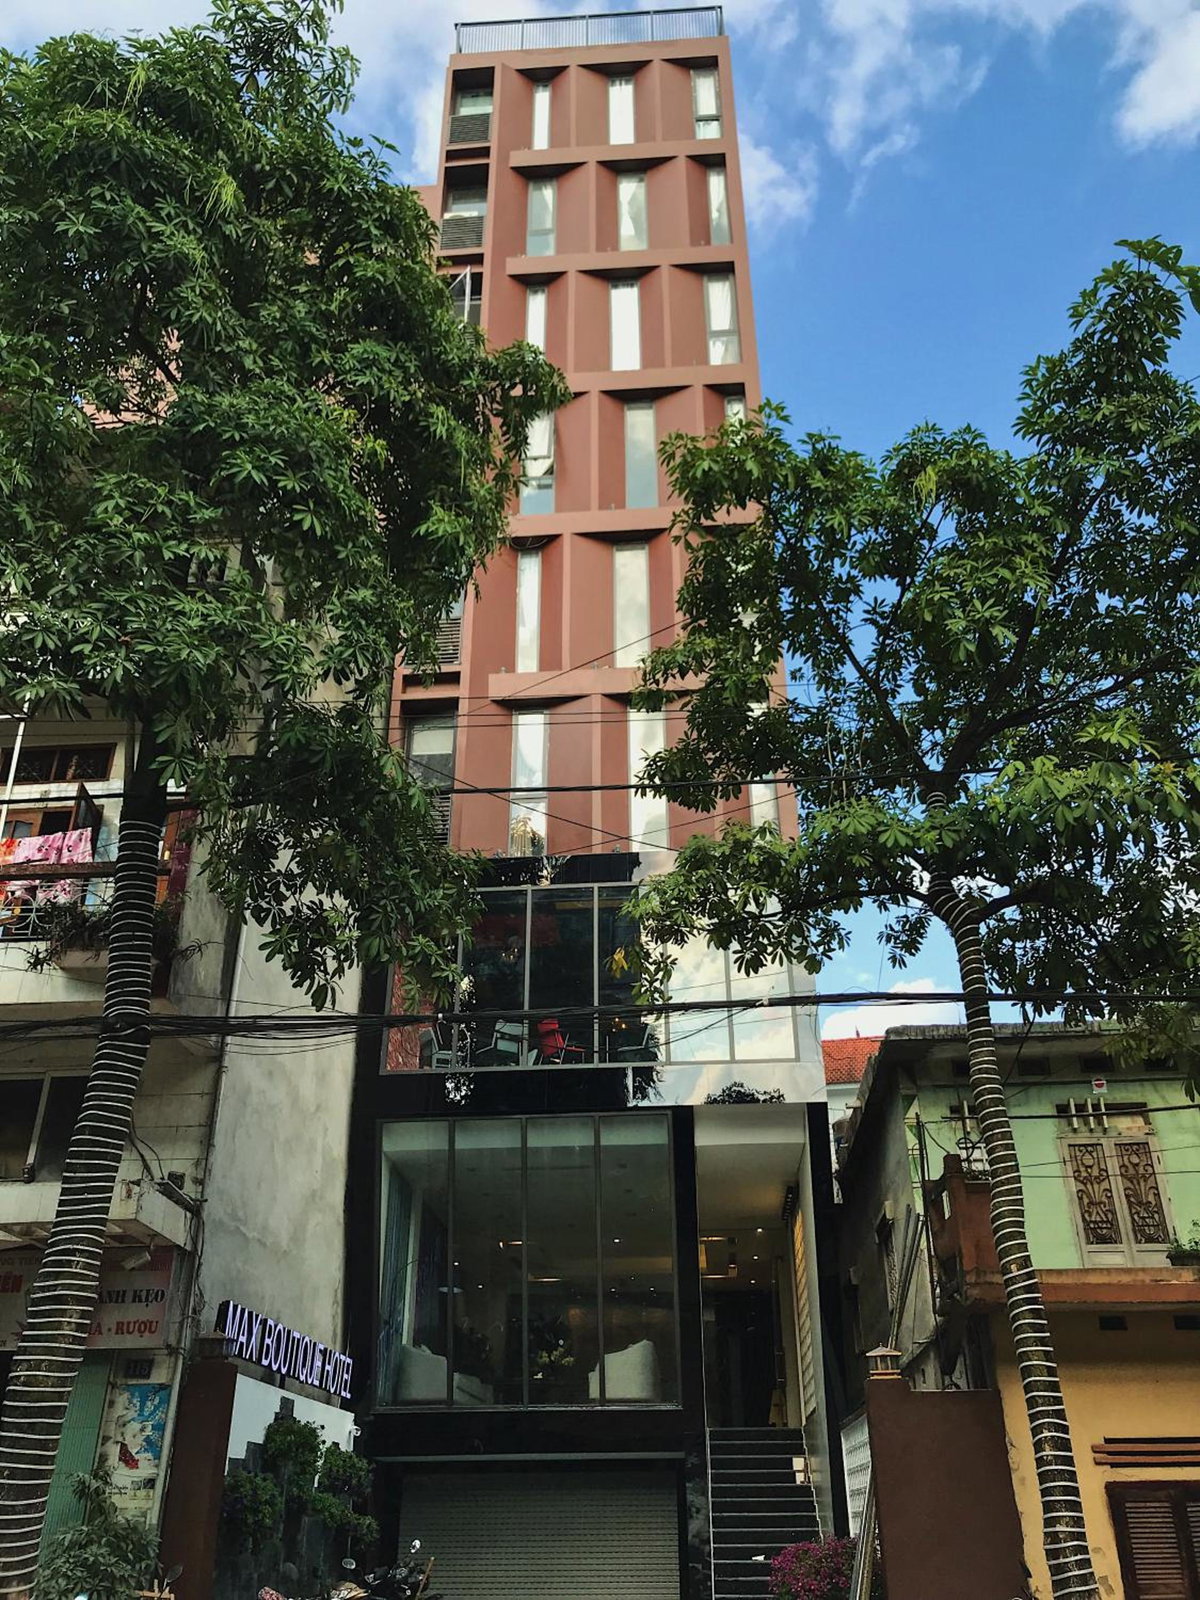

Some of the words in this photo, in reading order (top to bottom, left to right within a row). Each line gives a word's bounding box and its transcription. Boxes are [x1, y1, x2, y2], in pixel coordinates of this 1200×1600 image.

[131, 1288, 166, 1308] KẸO
[114, 1319, 159, 1338] RƯỢU
[225, 1300, 263, 1362] MAX
[261, 1318, 324, 1387] BOUTIQUE
[322, 1348, 353, 1399] HOTEL
